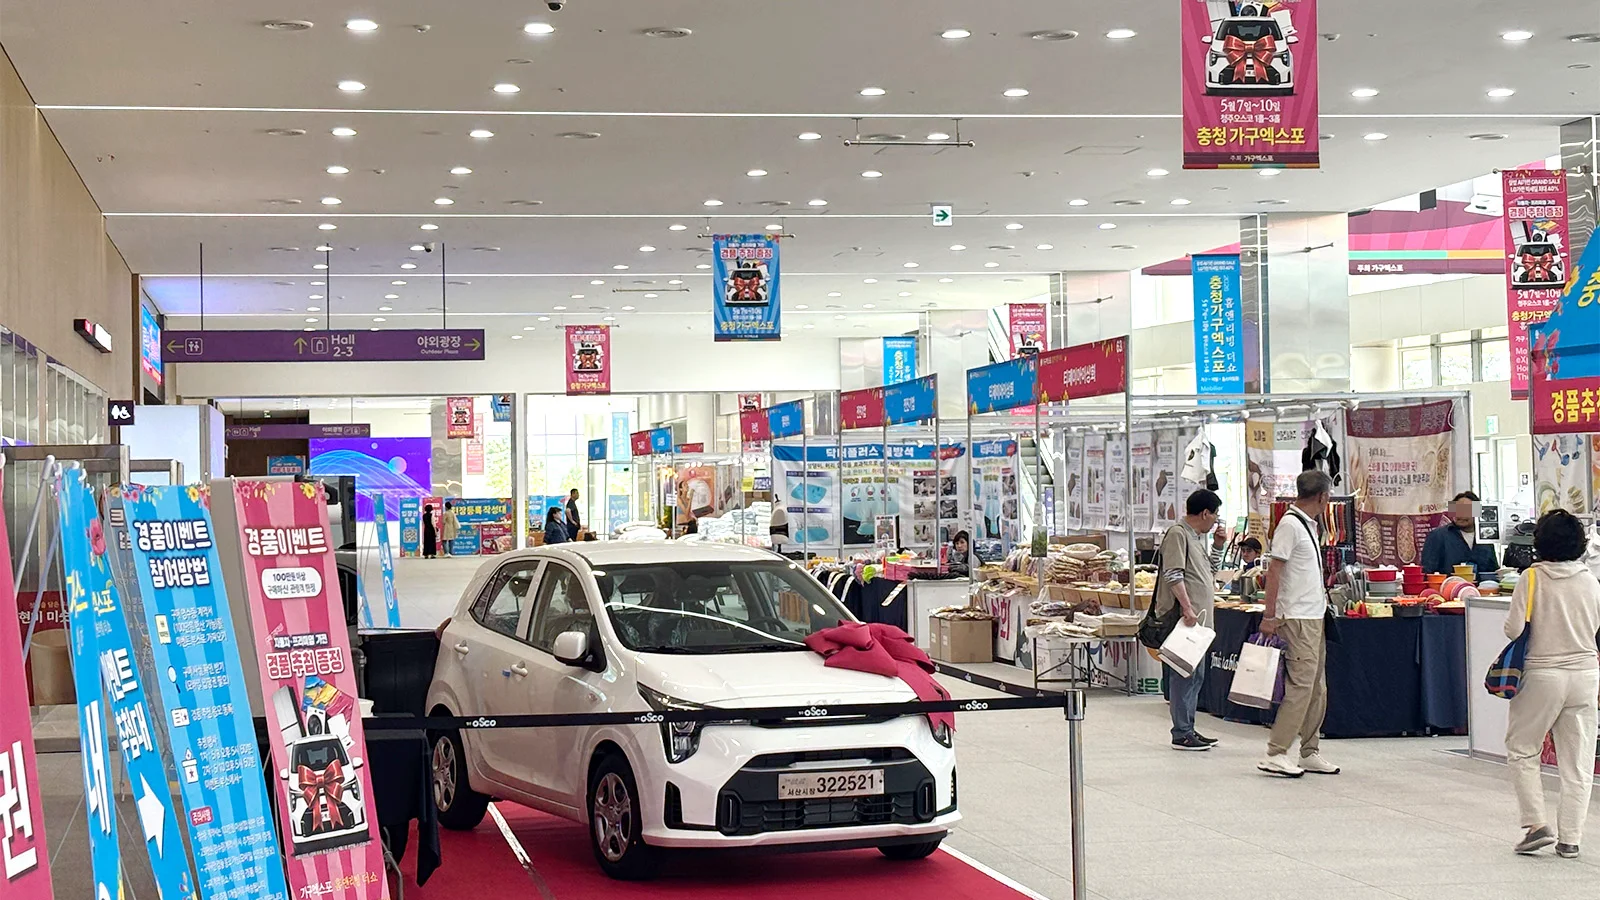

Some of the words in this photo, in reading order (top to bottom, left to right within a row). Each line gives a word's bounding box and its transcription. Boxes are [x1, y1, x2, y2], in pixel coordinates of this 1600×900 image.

[1220, 99, 1236, 112] 5월
[1236, 99, 1281, 112] 7일~10일
[1197, 127, 1227, 146] 충청
[1229, 127, 1305, 145] 가구엑스포
[1517, 289, 1529, 299] 5월
[331, 334, 355, 345] Hall
[417, 335, 461, 349] 야외광장
[333, 347, 354, 357] 2-3
[1551, 388, 1600, 423] 경품추
[134, 520, 212, 551] 경품이벤트
[245, 527, 328, 556] 경품이벤트
[149, 557, 210, 588] 참여방법
[266, 652, 292, 679] 경품
[290, 650, 318, 678] 추첨
[315, 647, 344, 675] 증정
[804, 706, 828, 717] oSco
[965, 700, 988, 711] oSco
[472, 717, 497, 727] oSco
[641, 712, 664, 723] oSco
[787, 787, 816, 796] 서산시장
[816, 774, 875, 793] 322521
